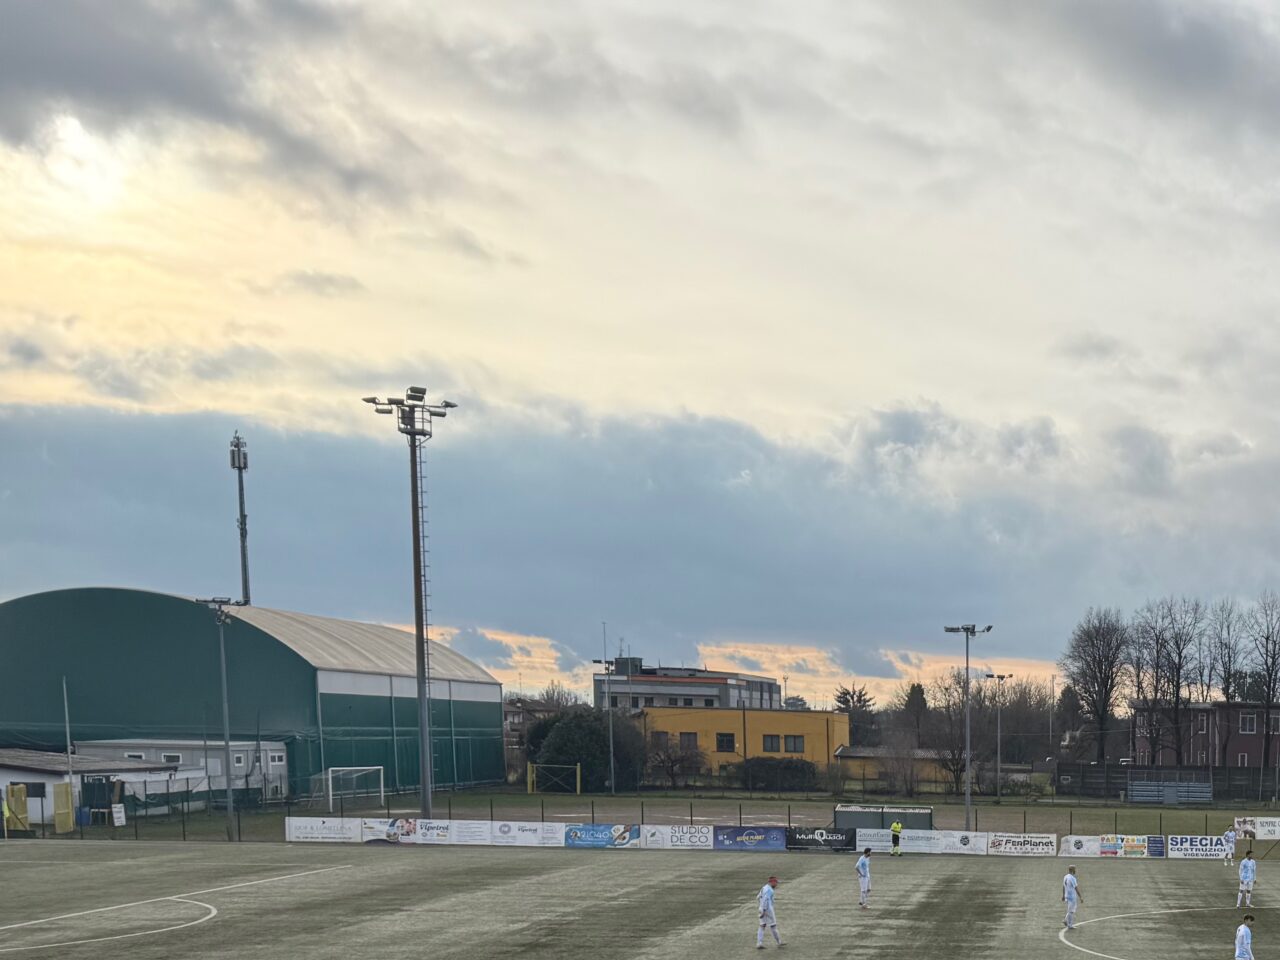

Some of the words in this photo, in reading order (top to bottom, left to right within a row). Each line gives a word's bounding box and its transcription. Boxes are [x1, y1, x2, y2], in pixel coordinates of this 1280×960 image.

[671, 825, 710, 835] STUDIO
[671, 835, 687, 843] DE
[688, 835, 709, 844] CO
